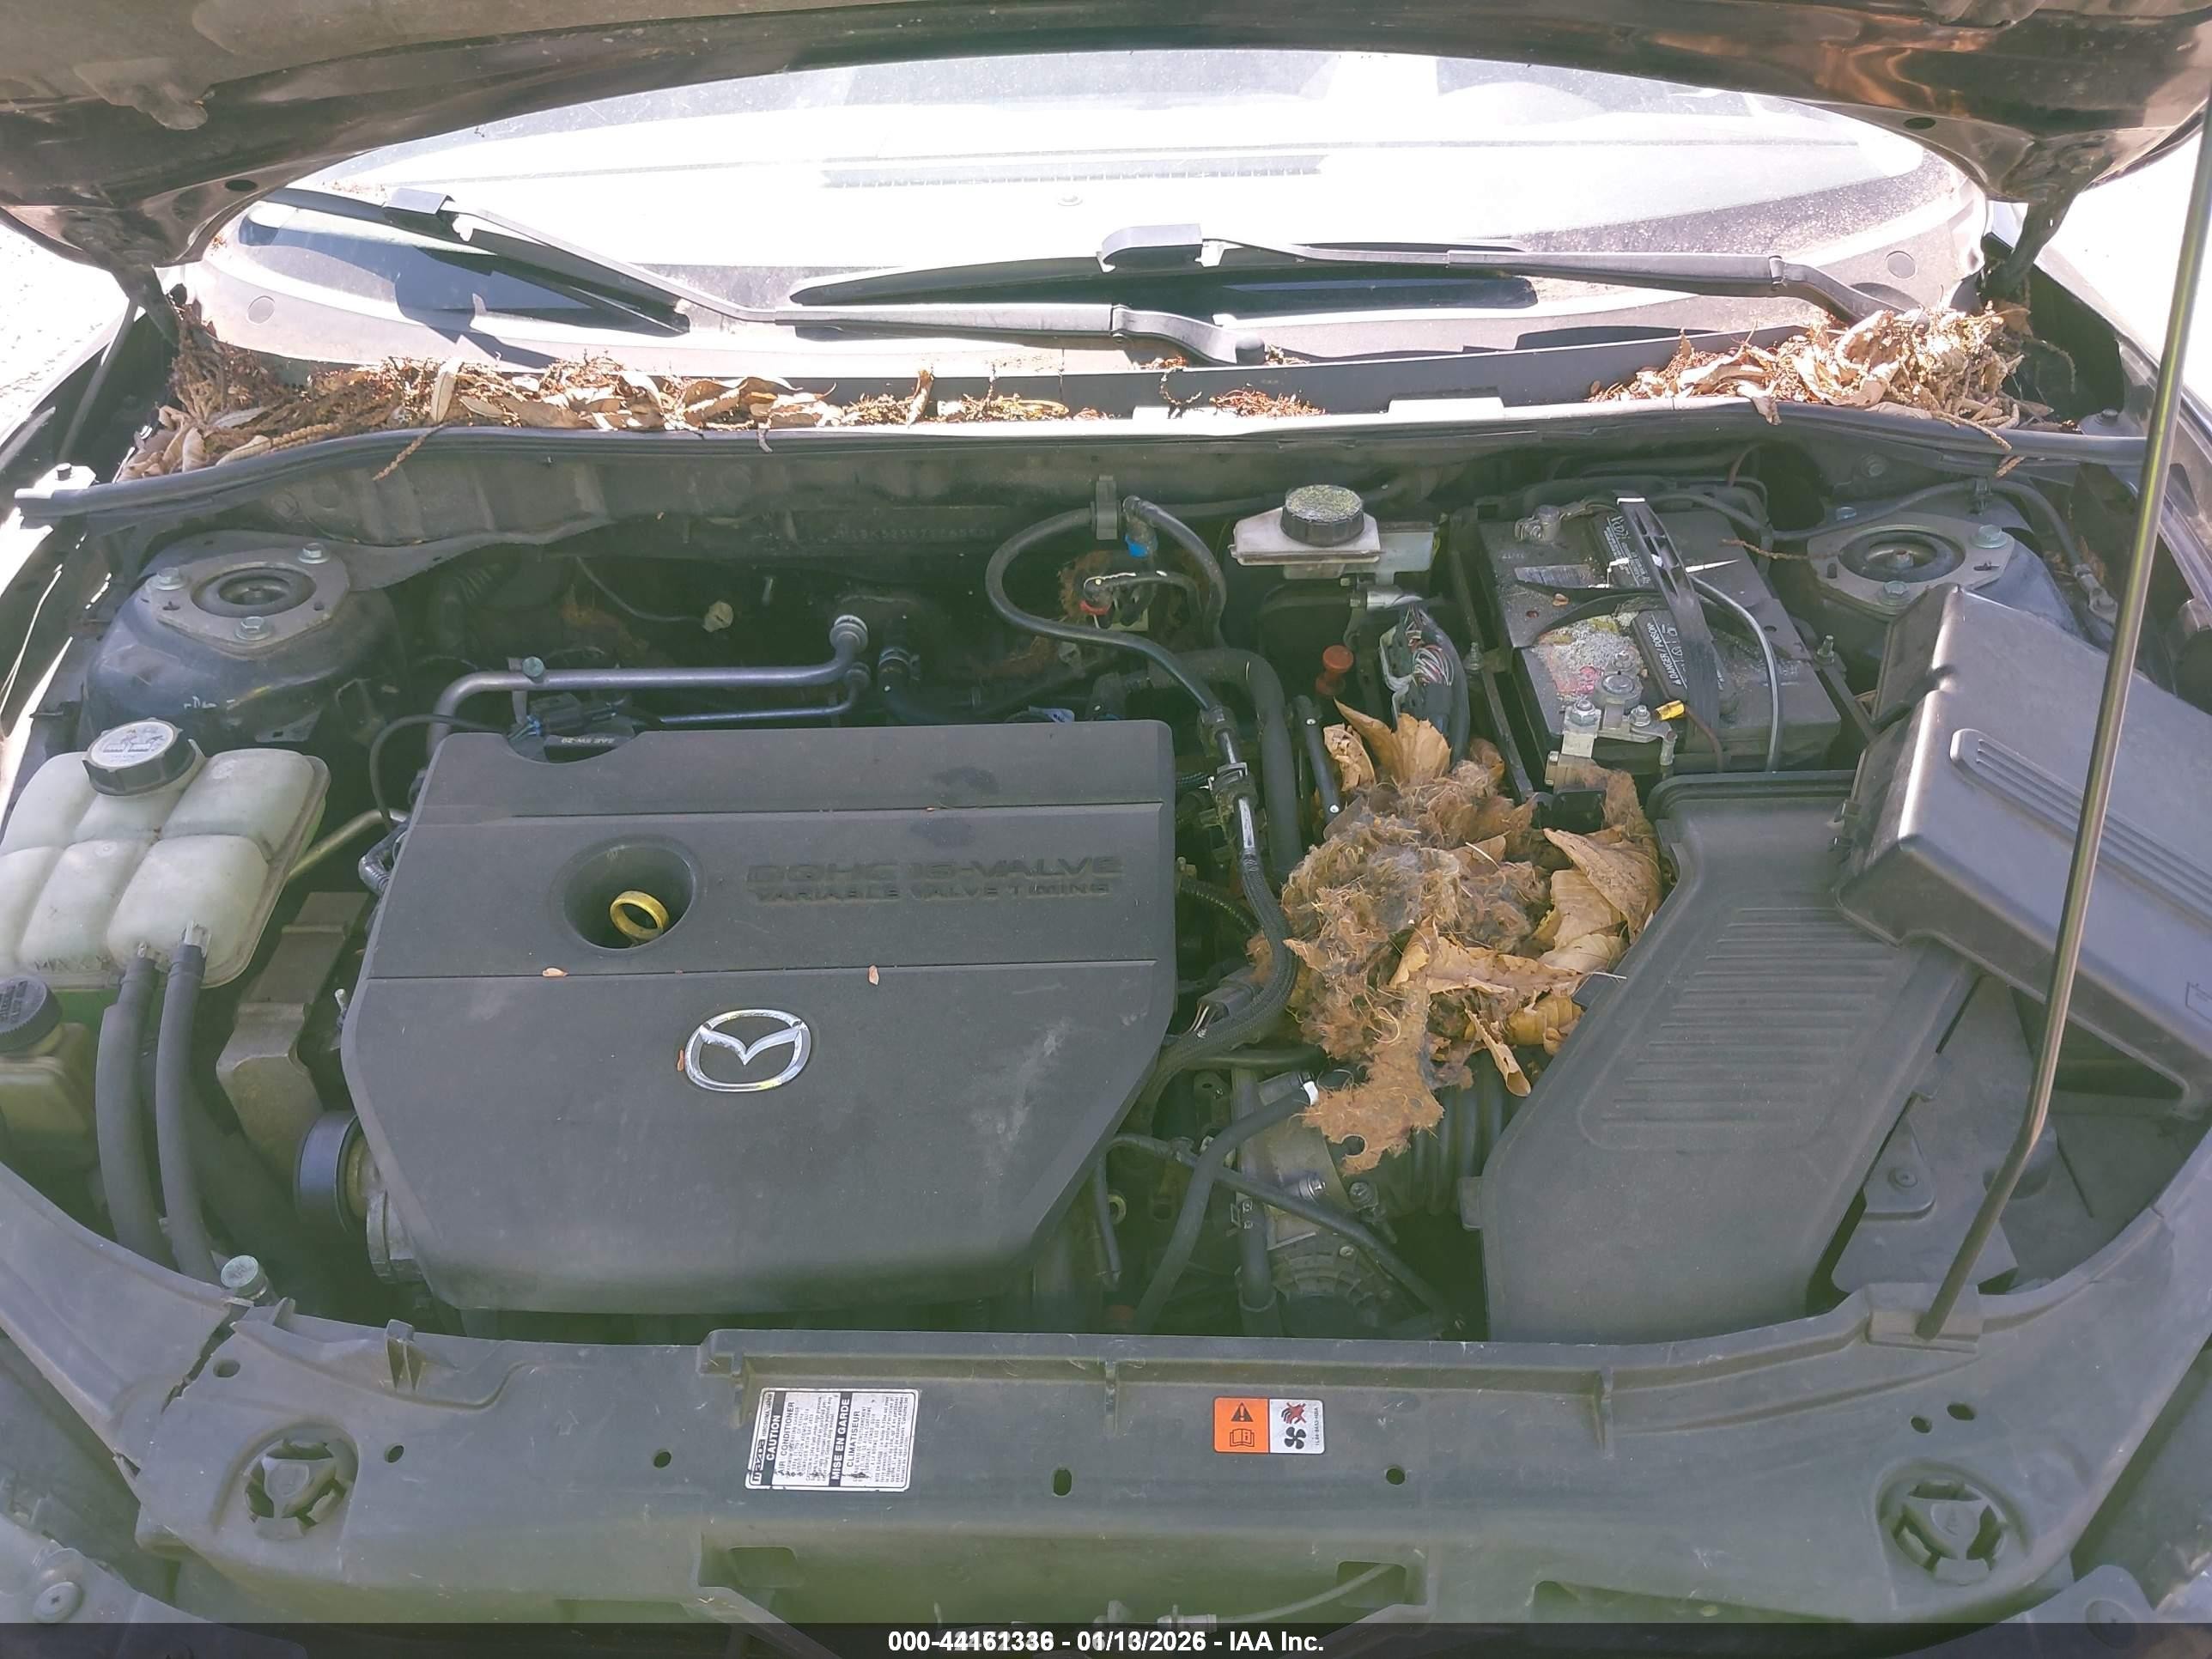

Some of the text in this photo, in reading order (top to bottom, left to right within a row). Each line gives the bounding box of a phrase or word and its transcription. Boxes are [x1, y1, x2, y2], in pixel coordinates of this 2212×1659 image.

[1647, 623, 1664, 647] POISON
[1660, 653, 1679, 679] DANGER
[747, 856, 1122, 882] DOHC 16-VALVE
[752, 881, 1111, 902] VARIABLE VALVE TIMING
[766, 1414, 781, 1460] CAUTION
[780, 1401, 794, 1455] CONDITIONER
[831, 1398, 849, 1480] MISE EN GARDE
[846, 1410, 860, 1467] CLIMATISEUR
